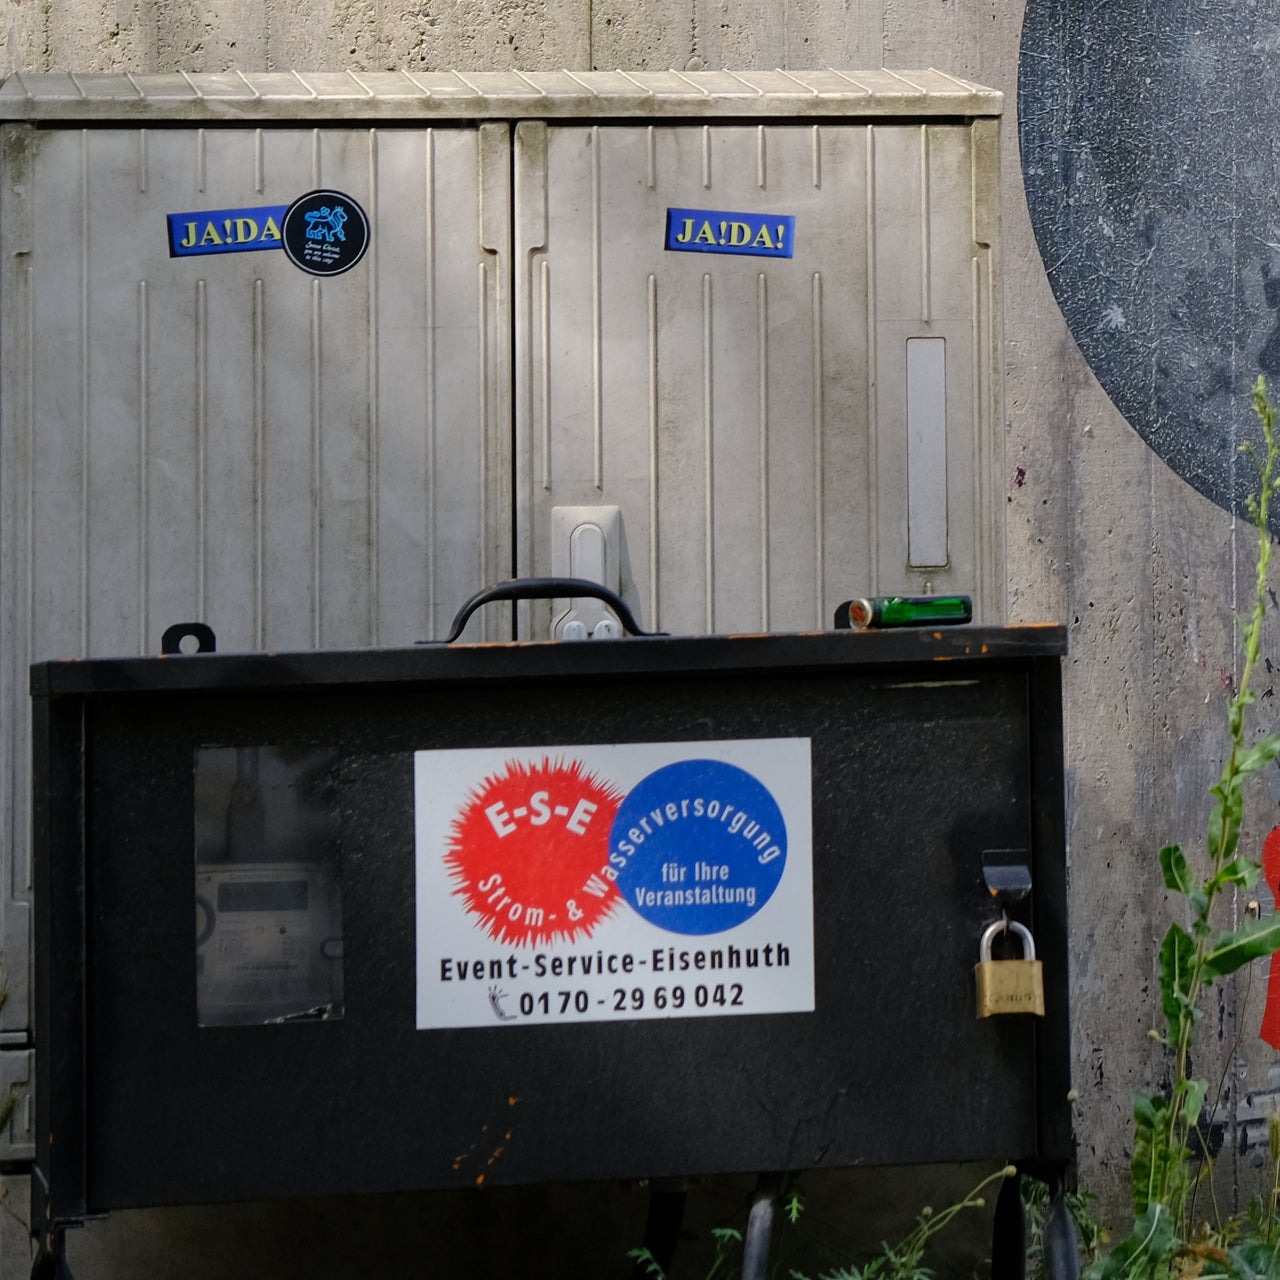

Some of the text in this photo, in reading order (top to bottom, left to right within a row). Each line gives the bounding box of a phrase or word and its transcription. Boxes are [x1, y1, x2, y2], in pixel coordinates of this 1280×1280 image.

[677, 219, 785, 249] JA!DA!
[484, 790, 599, 839] E-S-E
[566, 898, 584, 922] &
[582, 797, 781, 899] Wasserversorgung
[661, 861, 730, 883] für Ihre
[635, 884, 757, 907] Veranstaltung
[440, 942, 791, 982] Event-Service-Eisenhuth
